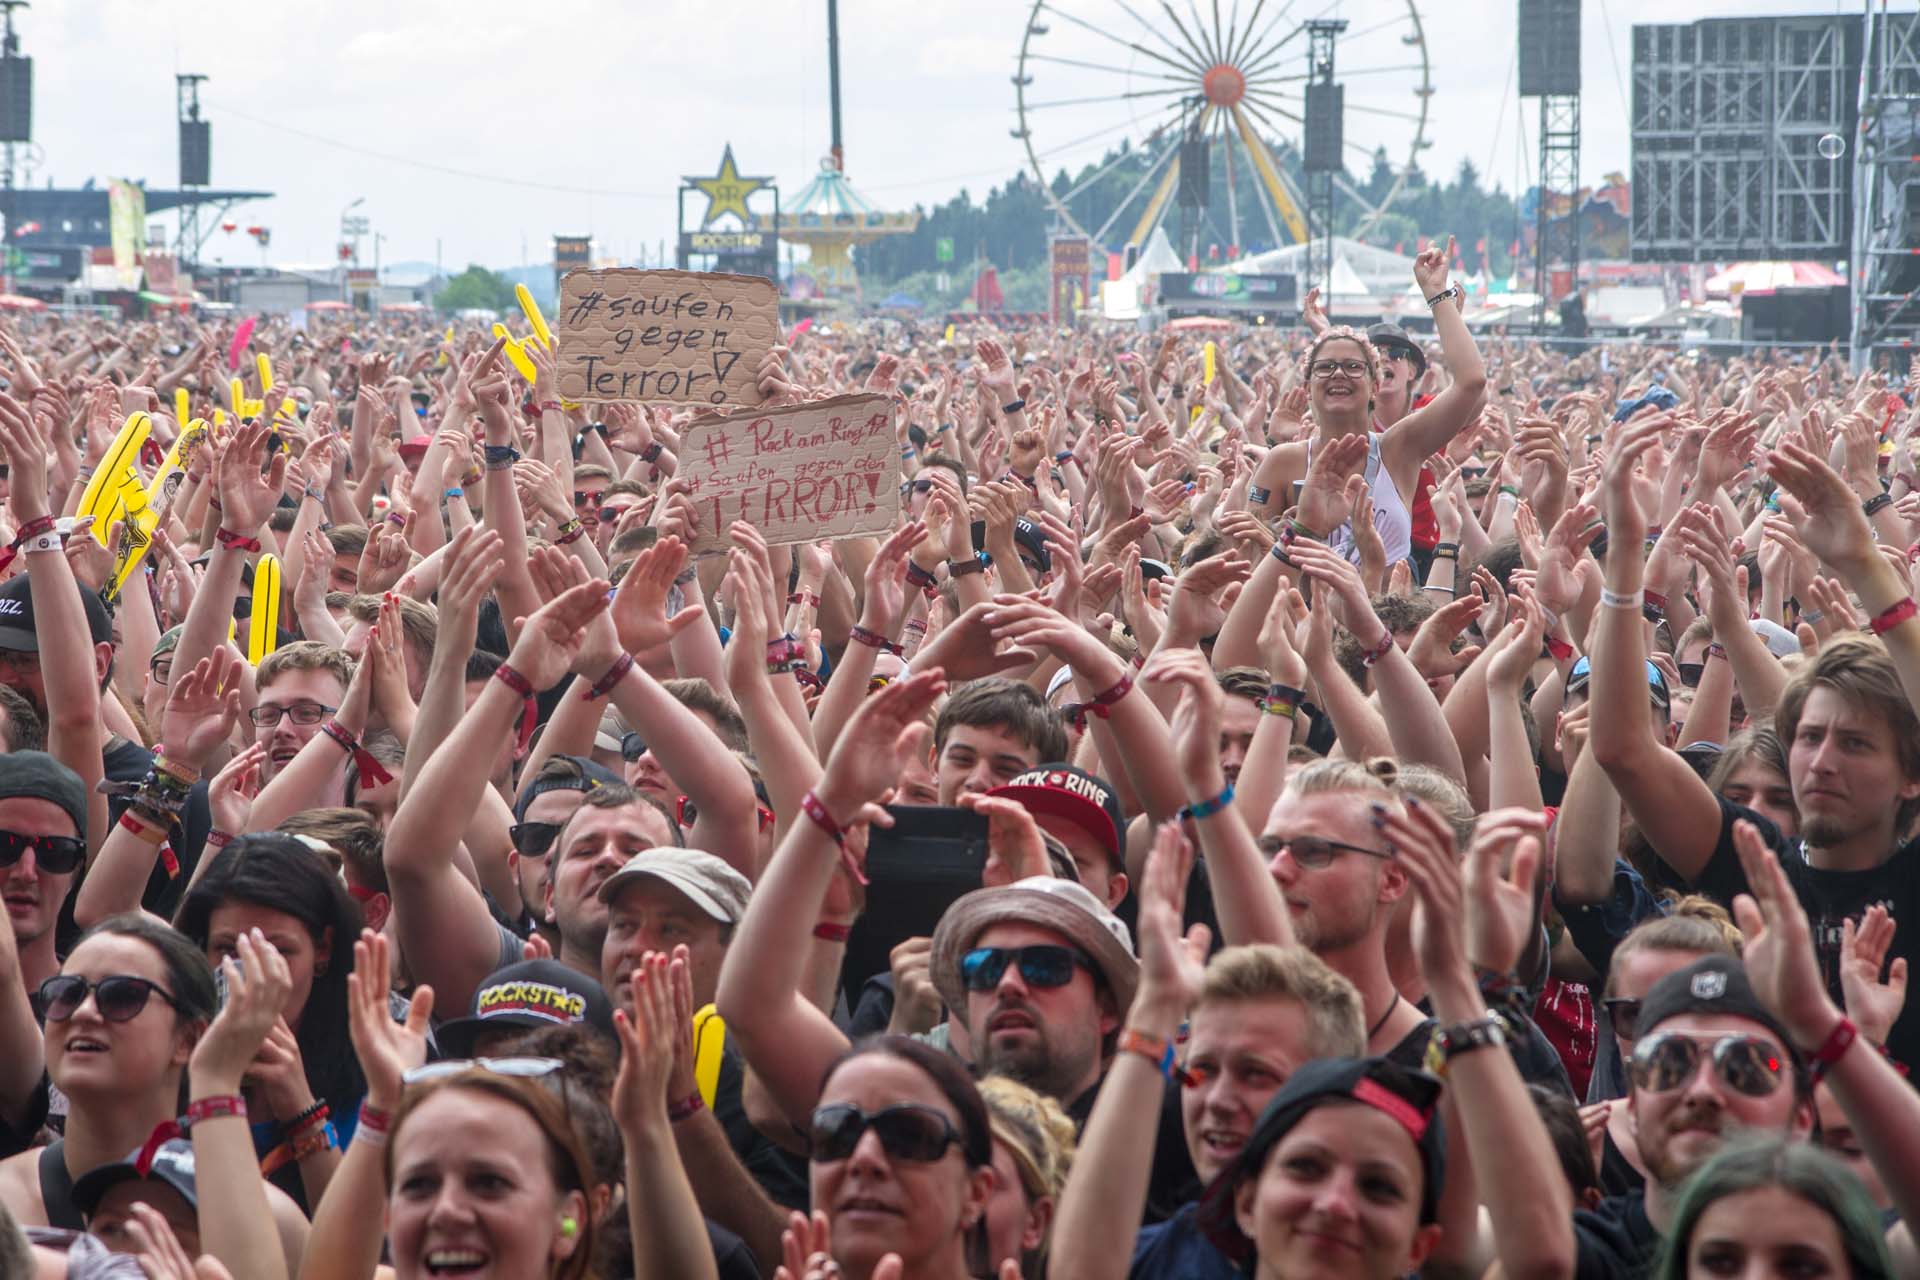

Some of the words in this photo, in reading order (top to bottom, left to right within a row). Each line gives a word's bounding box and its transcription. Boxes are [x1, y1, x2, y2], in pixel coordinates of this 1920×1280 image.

[568, 291, 733, 325] #saufen
[614, 326, 728, 356] gegen
[576, 351, 742, 404] Terror!
[799, 433, 824, 449] am
[828, 416, 864, 446] Ring
[795, 460, 844, 480] gegen
[854, 452, 886, 472] den
[705, 472, 881, 539] TERROR!
[1064, 773, 1109, 808] RING
